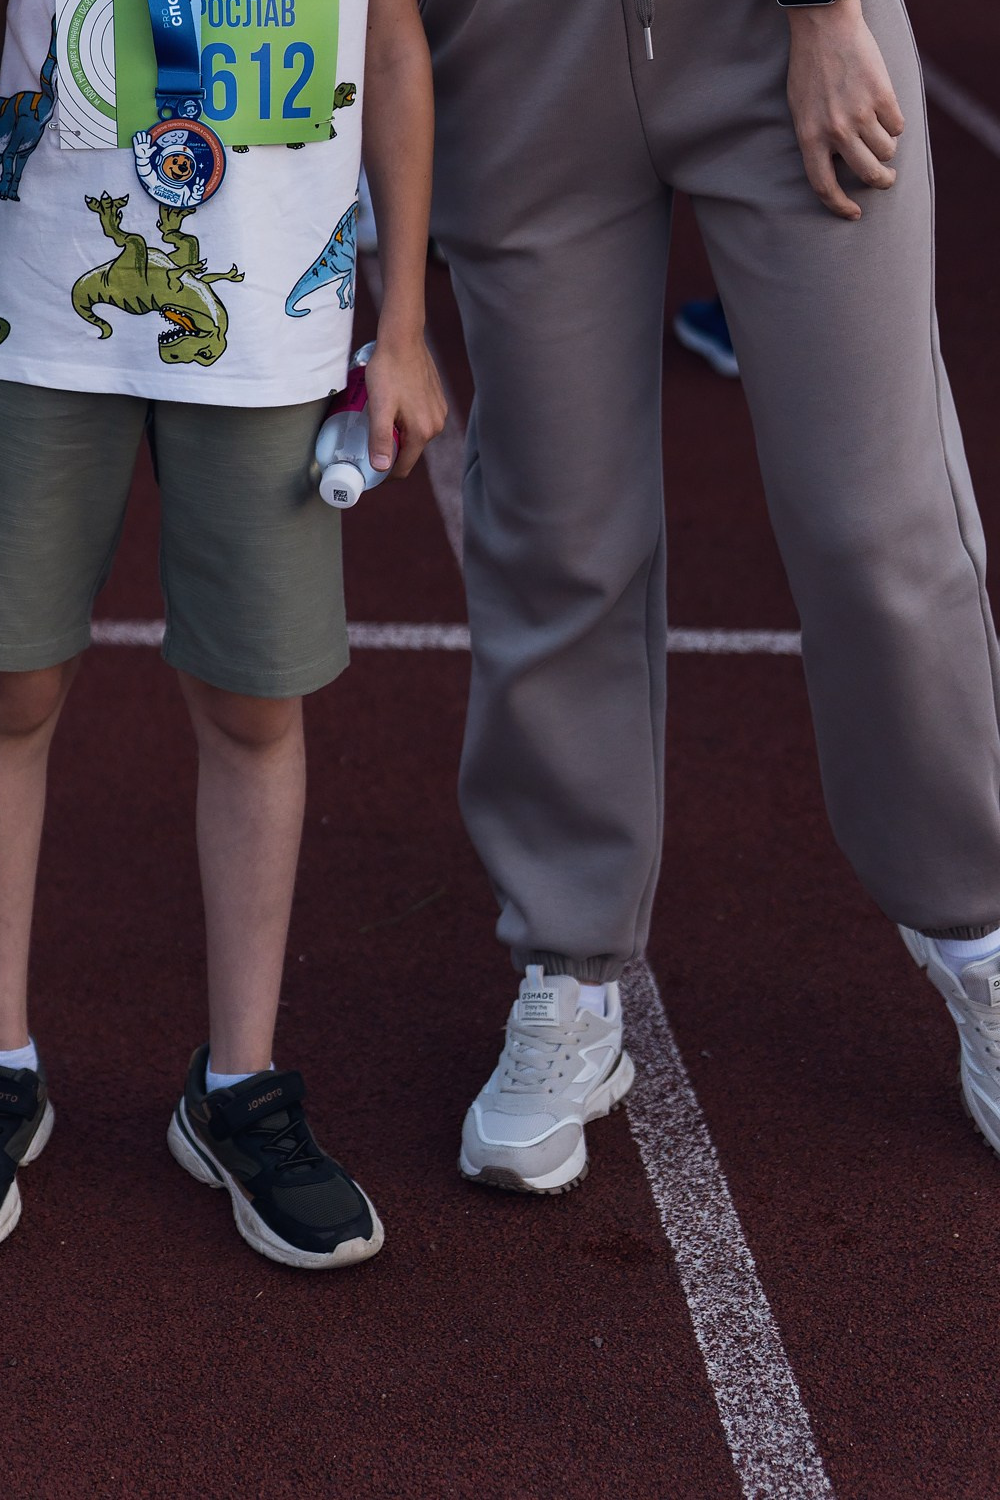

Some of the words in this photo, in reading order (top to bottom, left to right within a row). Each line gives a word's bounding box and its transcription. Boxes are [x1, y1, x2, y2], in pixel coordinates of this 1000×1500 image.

[161, 8, 171, 29] PRO
[83, 86, 97, 100] 600
[247, 1087, 283, 1111] JOMOTO
